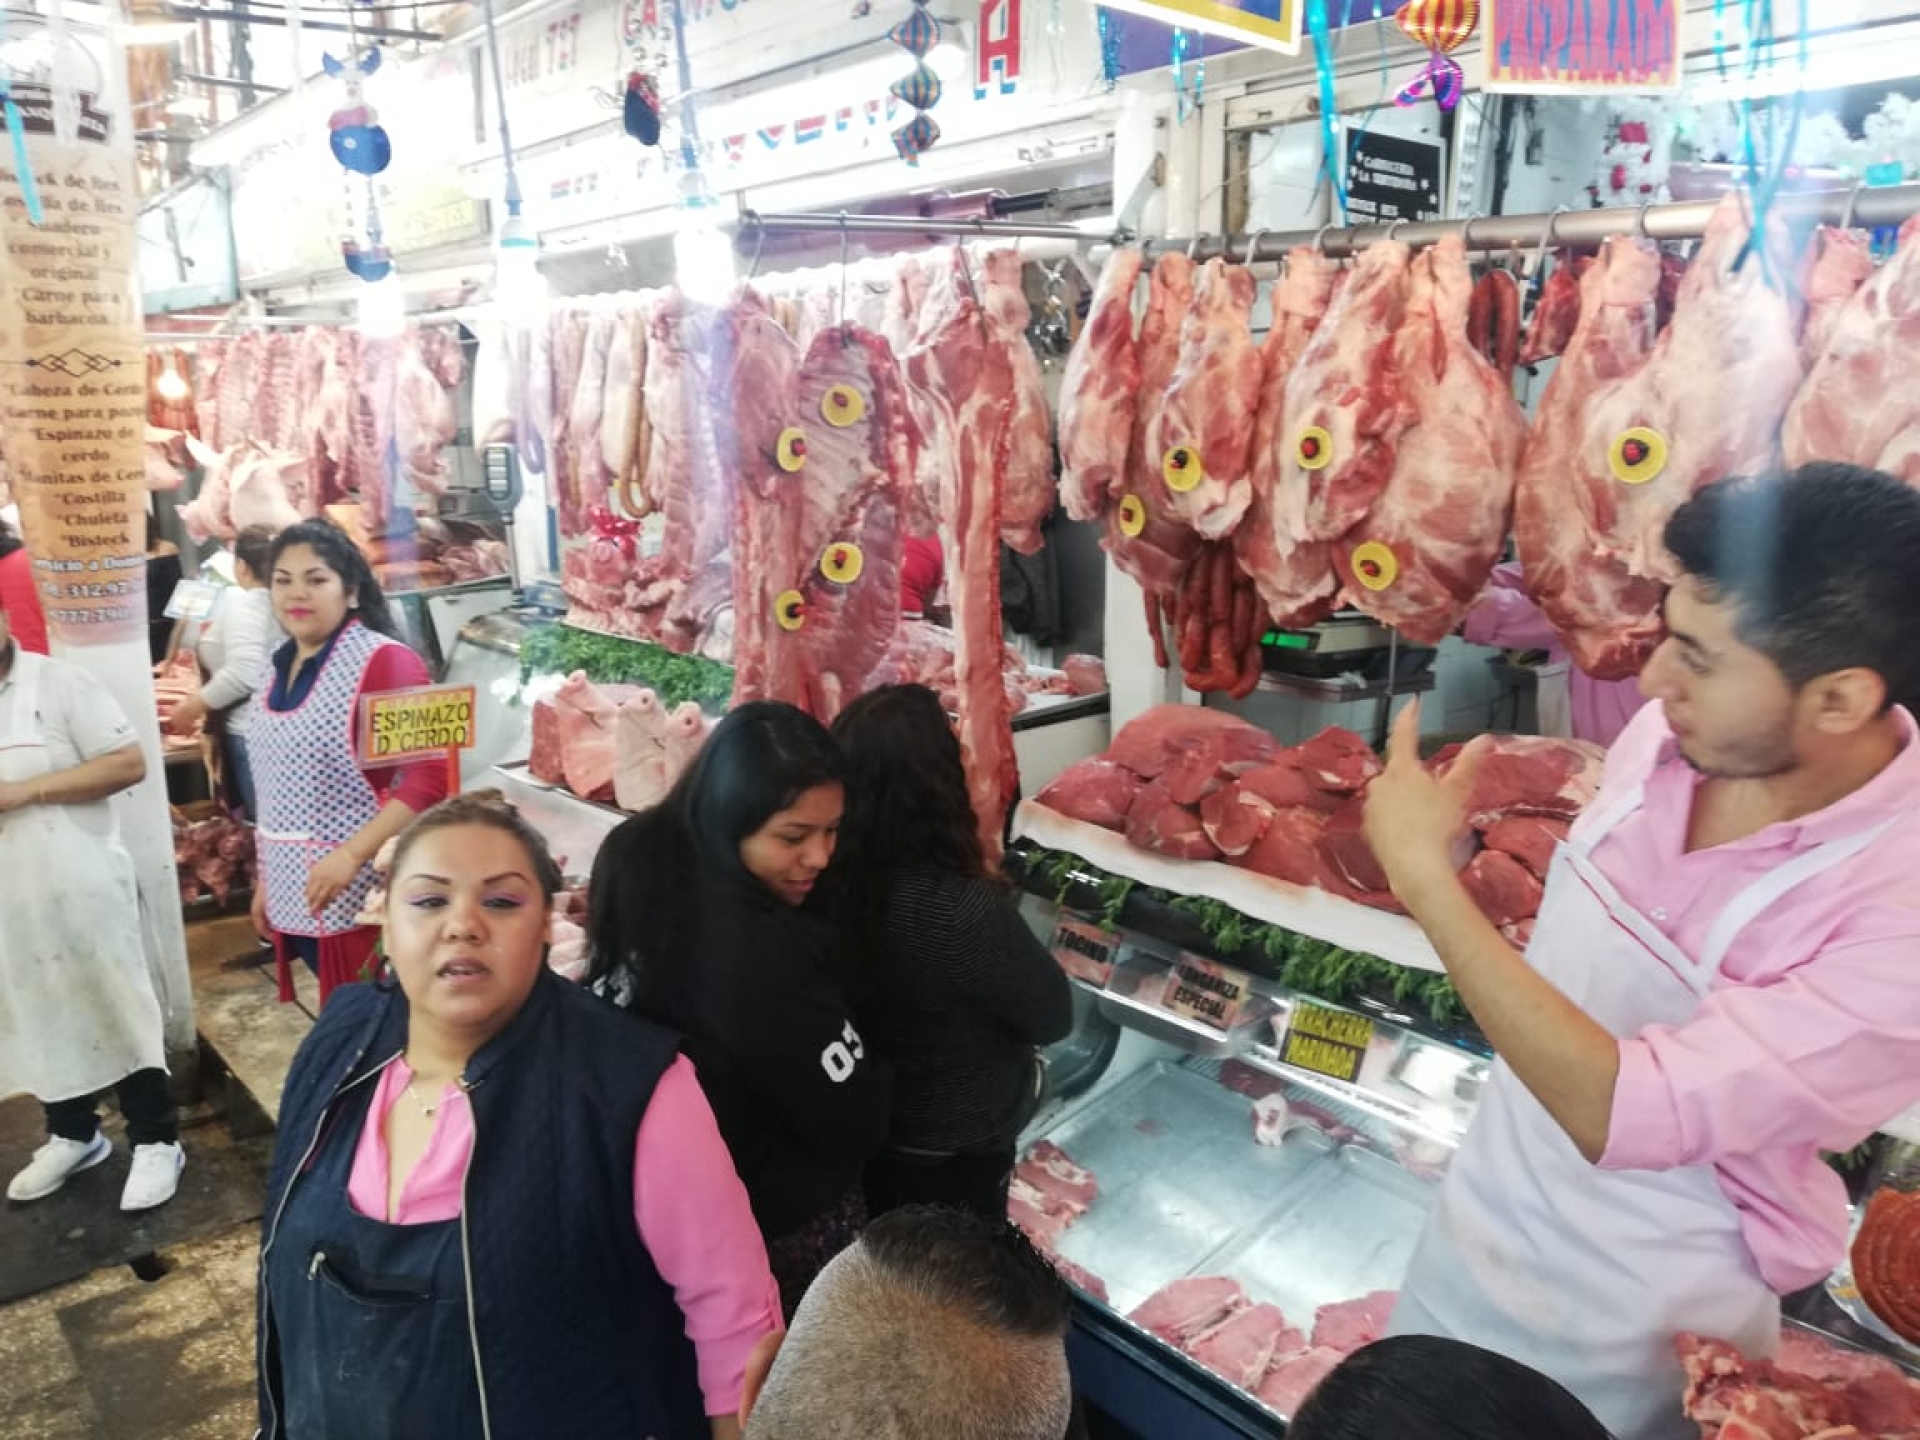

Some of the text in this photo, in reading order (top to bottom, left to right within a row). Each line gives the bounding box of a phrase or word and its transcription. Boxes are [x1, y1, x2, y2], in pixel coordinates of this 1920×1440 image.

[63, 409, 103, 421] para
[61, 449, 110, 462] cerdo
[89, 470, 110, 483] de
[372, 702, 470, 733] ESPINAZO
[1174, 985, 1226, 1020] ESPECIAL
